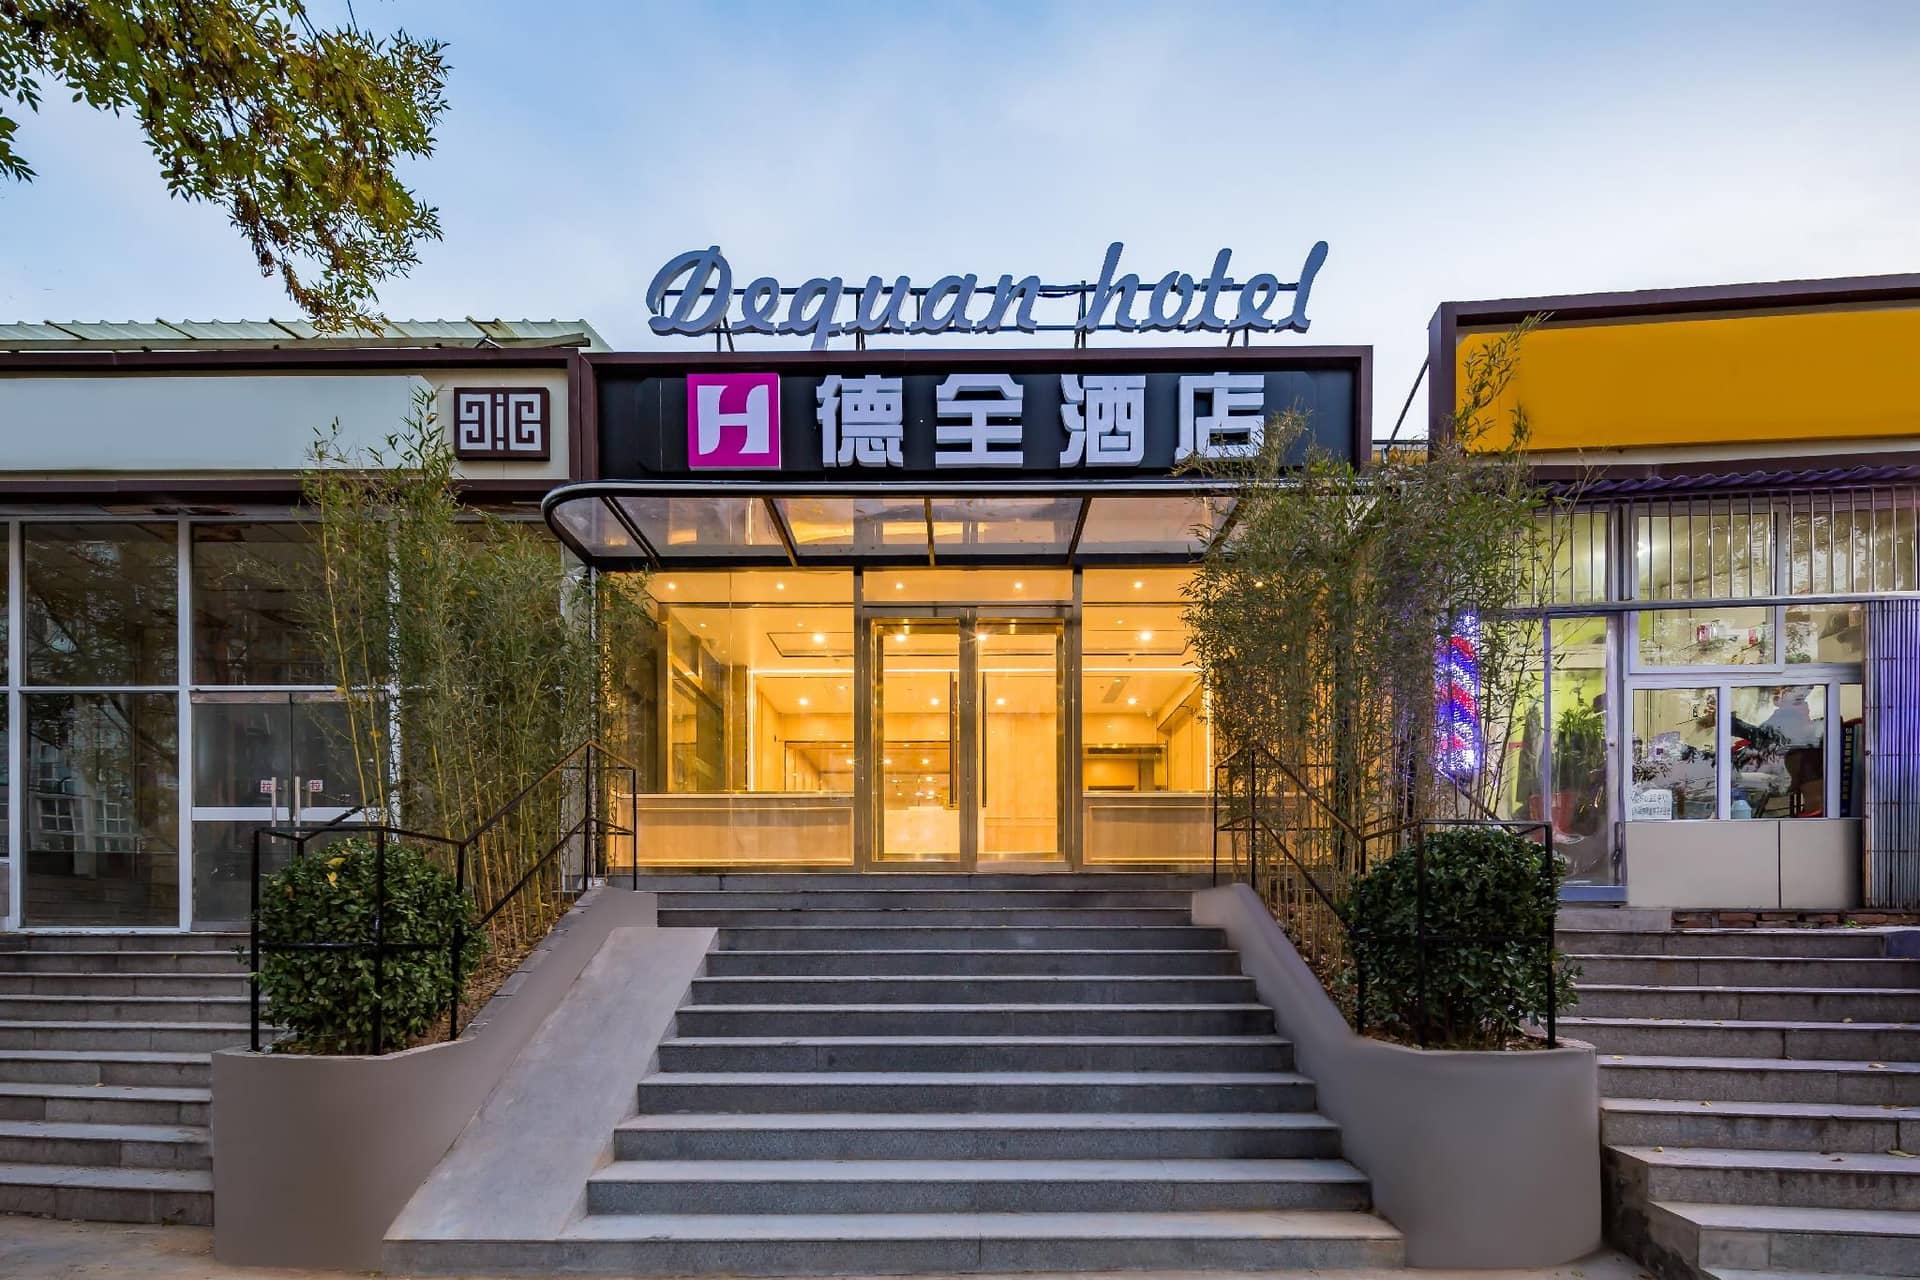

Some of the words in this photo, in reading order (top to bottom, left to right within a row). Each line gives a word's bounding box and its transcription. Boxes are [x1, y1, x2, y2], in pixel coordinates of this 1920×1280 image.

[646, 245, 1038, 351] Dequan
[1074, 241, 1329, 334] hotel
[697, 384, 770, 456] H
[815, 372, 1265, 469] 德全酒店
